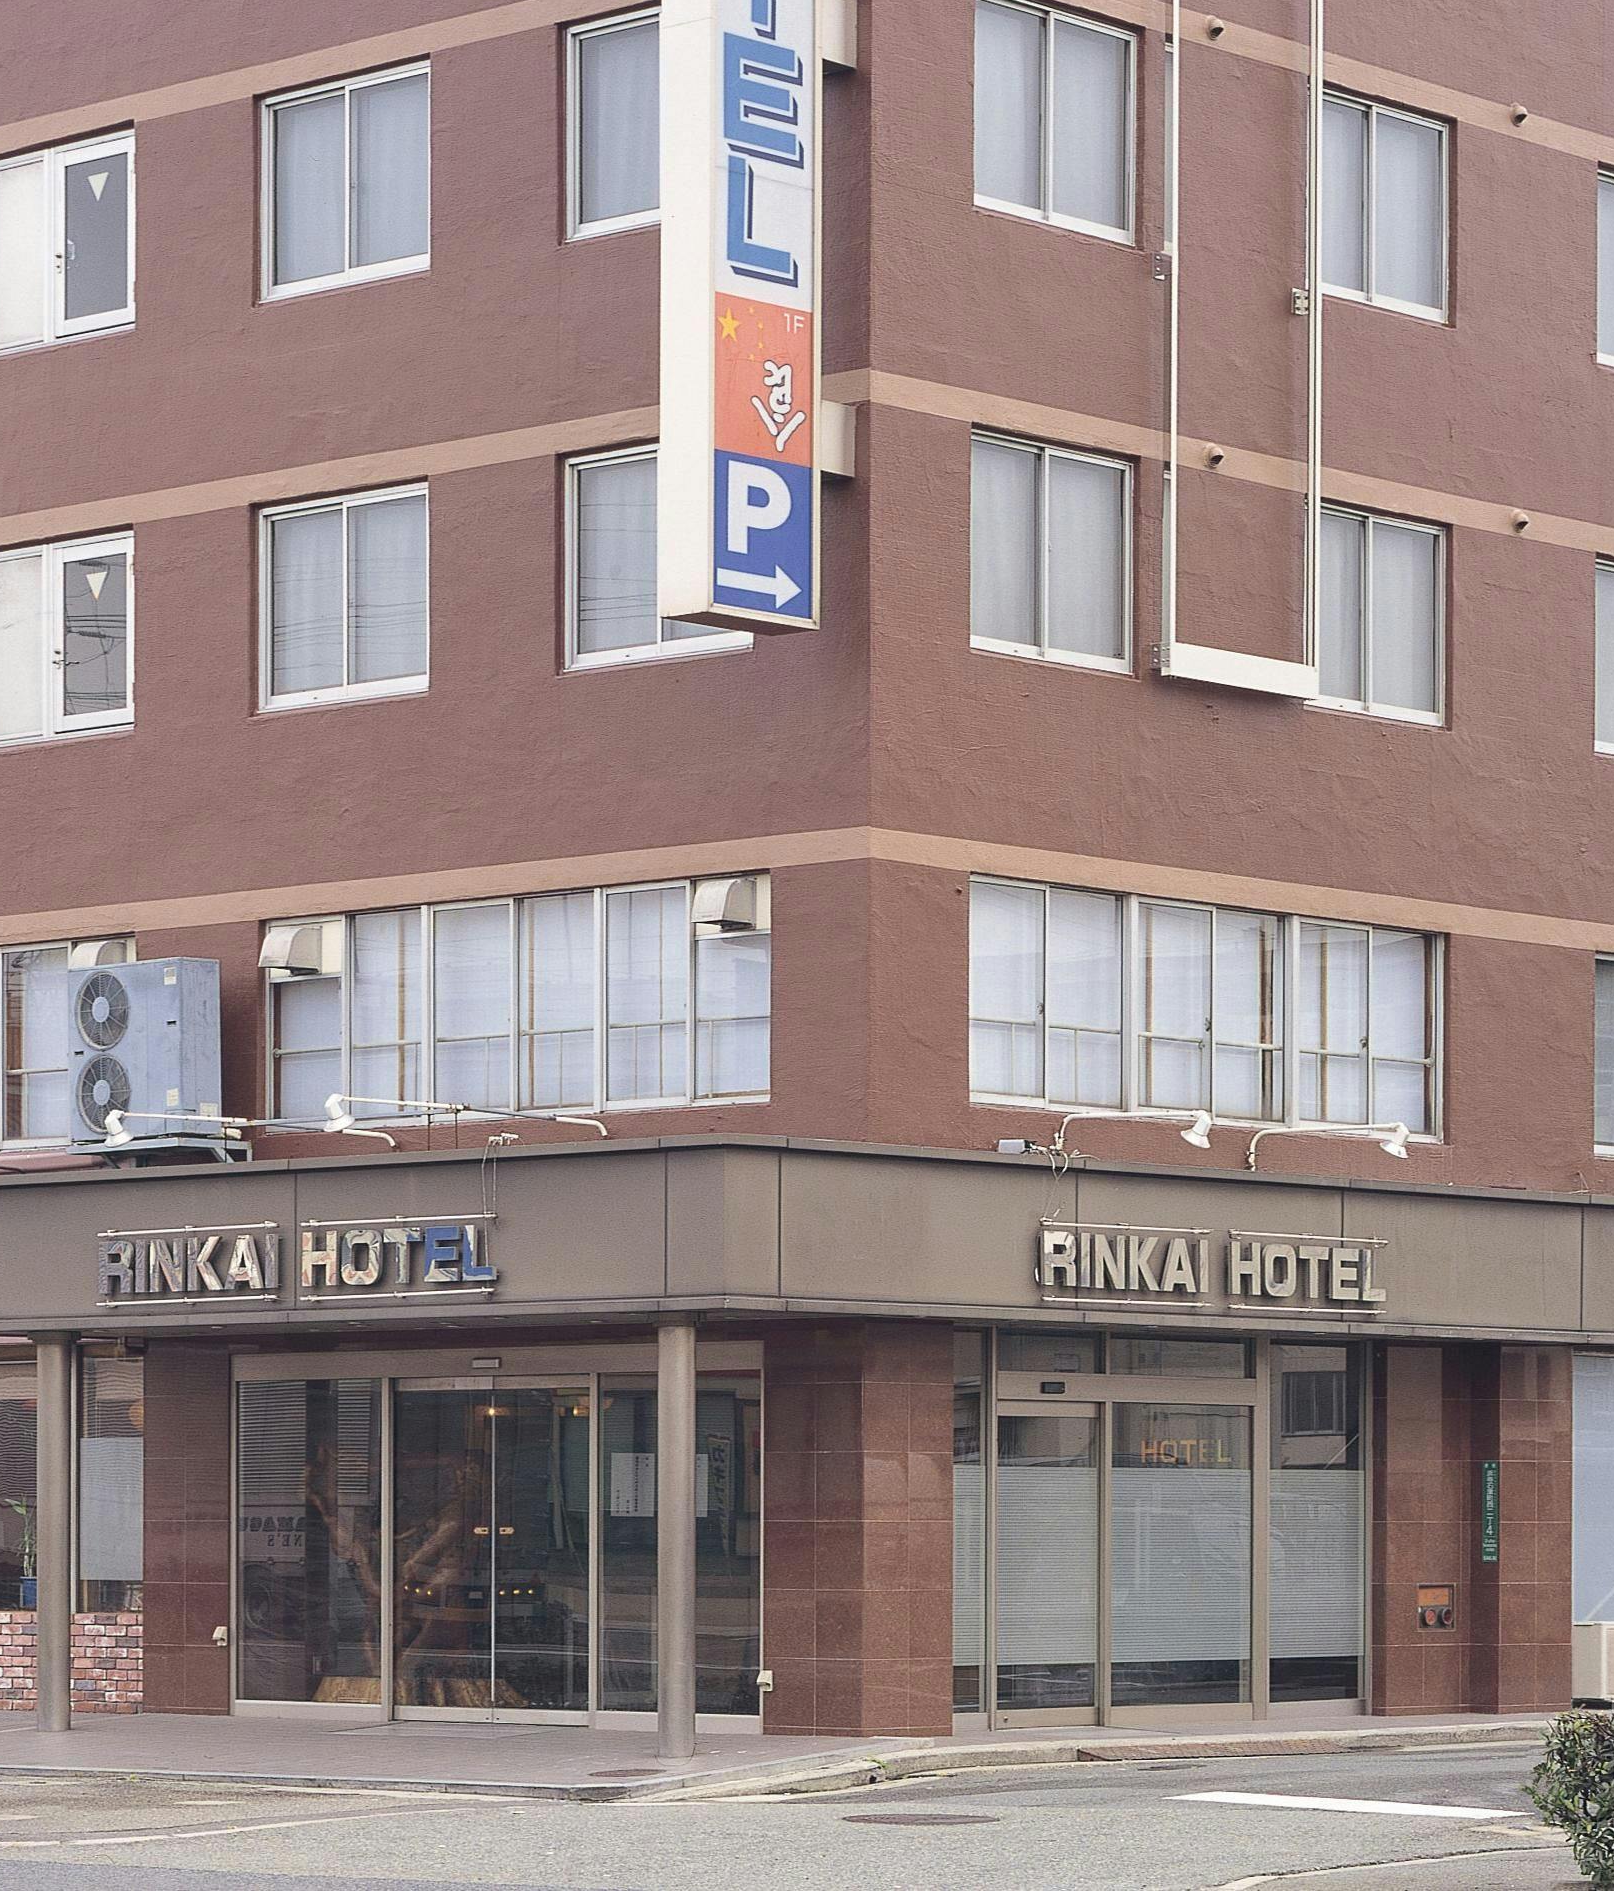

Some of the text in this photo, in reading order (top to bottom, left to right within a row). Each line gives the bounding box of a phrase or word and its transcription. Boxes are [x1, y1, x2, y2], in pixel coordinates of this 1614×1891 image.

[784, 312, 805, 335] 1F
[726, 458, 793, 556] P
[98, 1224, 498, 1295] RINKAI HOTEL
[1040, 1229, 1387, 1302] RINKAI HOTEL
[1139, 1438, 1232, 1464] HOTEL
